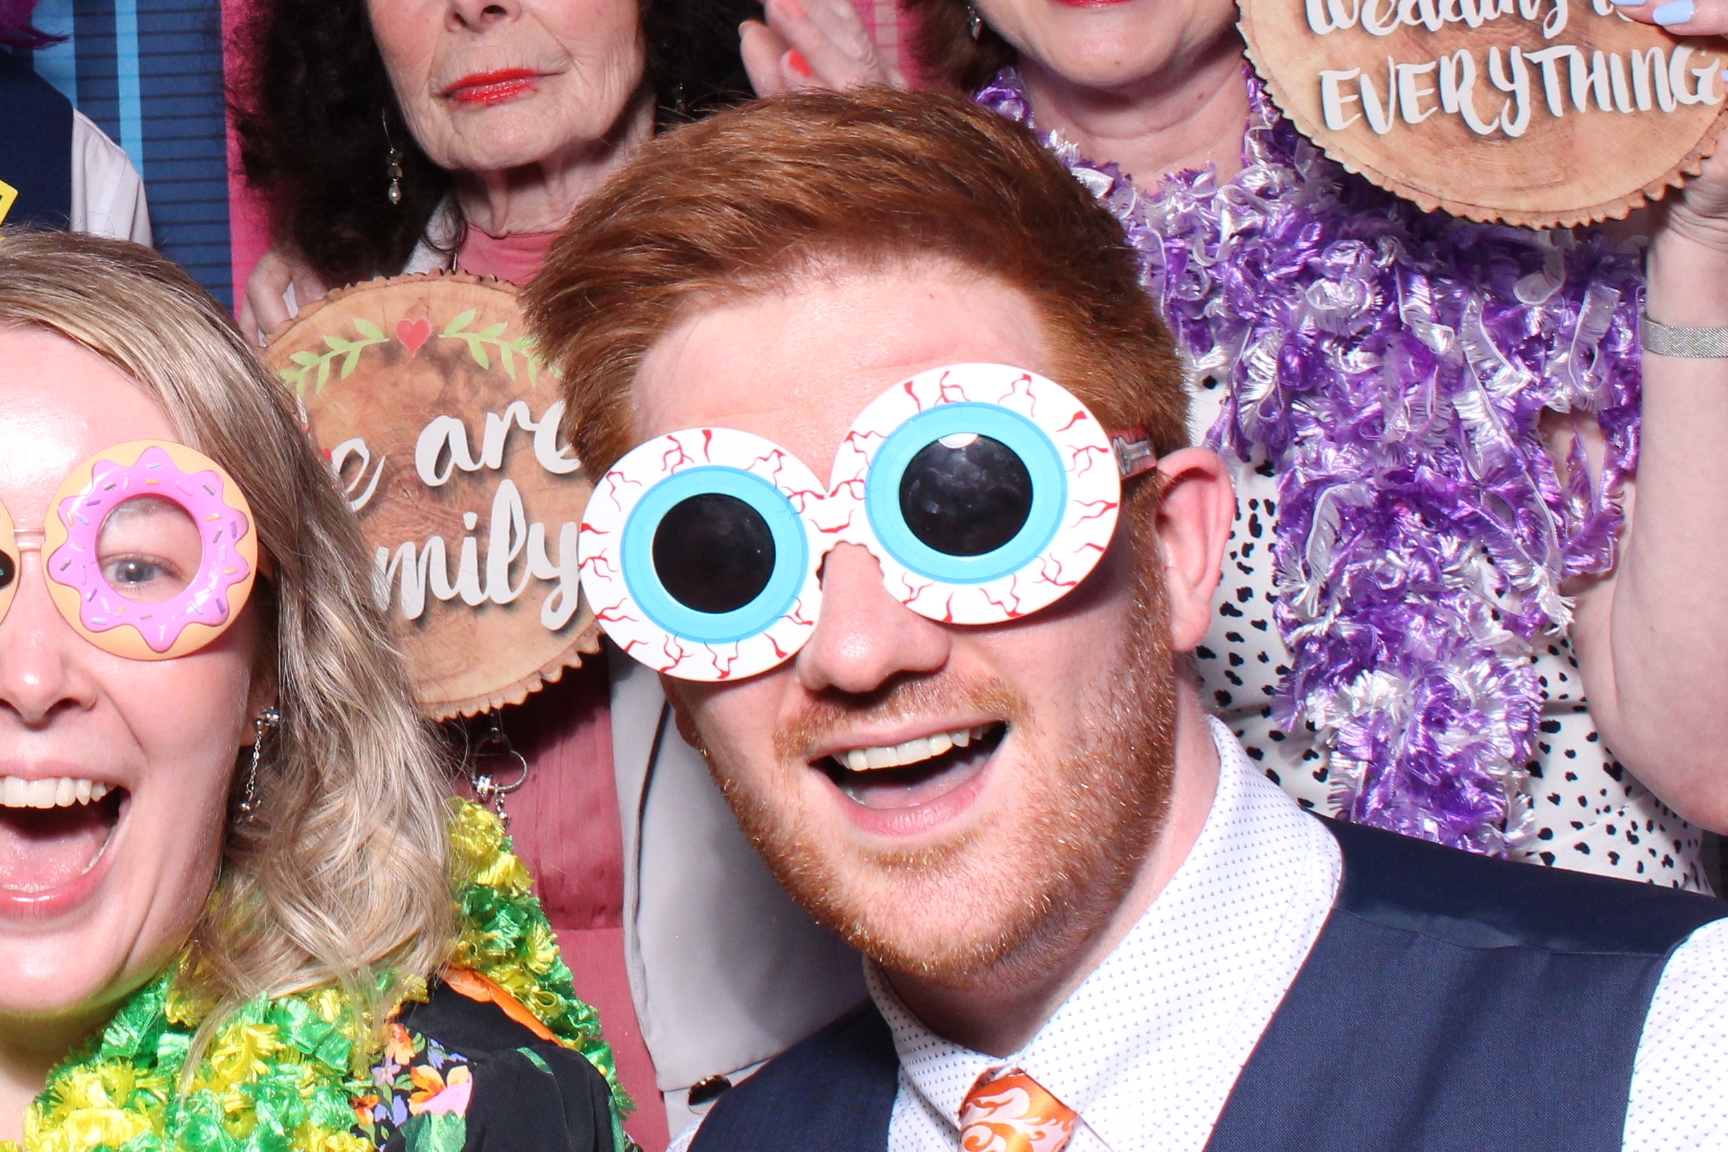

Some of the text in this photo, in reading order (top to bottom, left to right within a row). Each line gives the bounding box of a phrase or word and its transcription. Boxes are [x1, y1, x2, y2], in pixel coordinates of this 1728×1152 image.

[1319, 37, 1724, 138] EVERYTHING
[330, 436, 386, 512] e
[373, 478, 580, 631] mily
